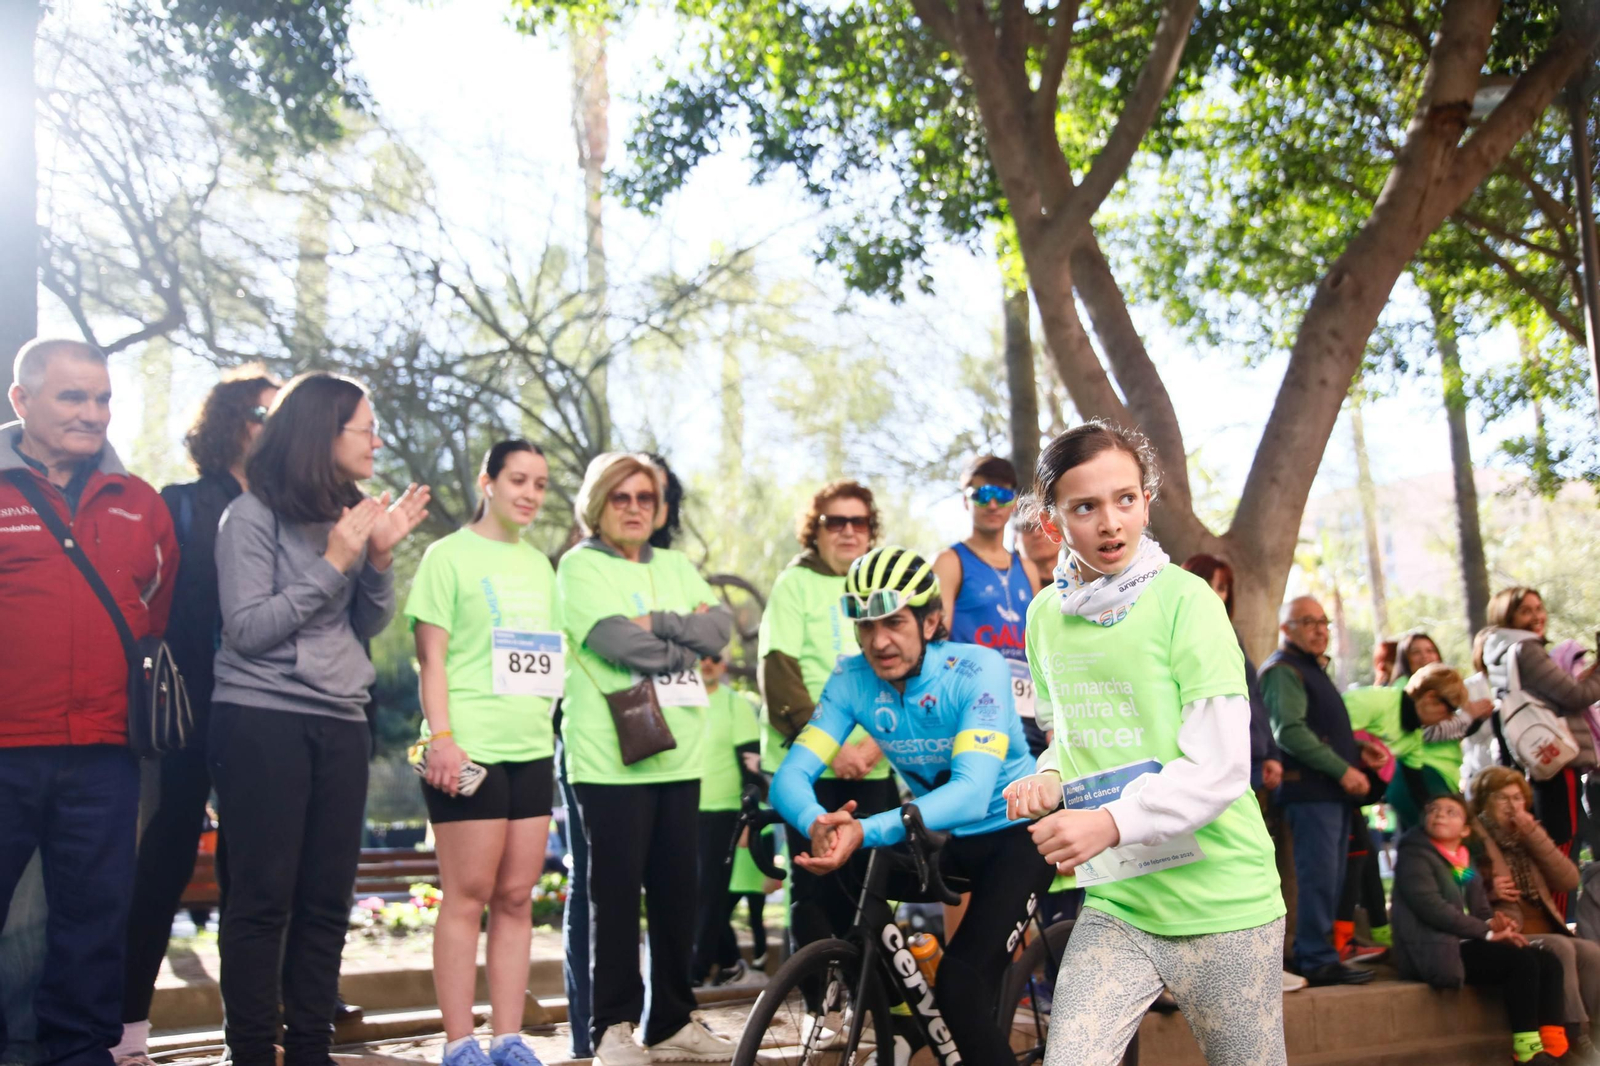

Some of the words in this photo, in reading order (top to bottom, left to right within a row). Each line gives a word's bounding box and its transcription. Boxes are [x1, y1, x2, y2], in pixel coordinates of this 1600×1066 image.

[509, 651, 551, 675] 829
[657, 669, 699, 686] 524
[1073, 677, 1133, 696] marcha
[1119, 697, 1139, 717] el
[1083, 792, 1093, 801] el
[1093, 785, 1121, 799] cáncer
